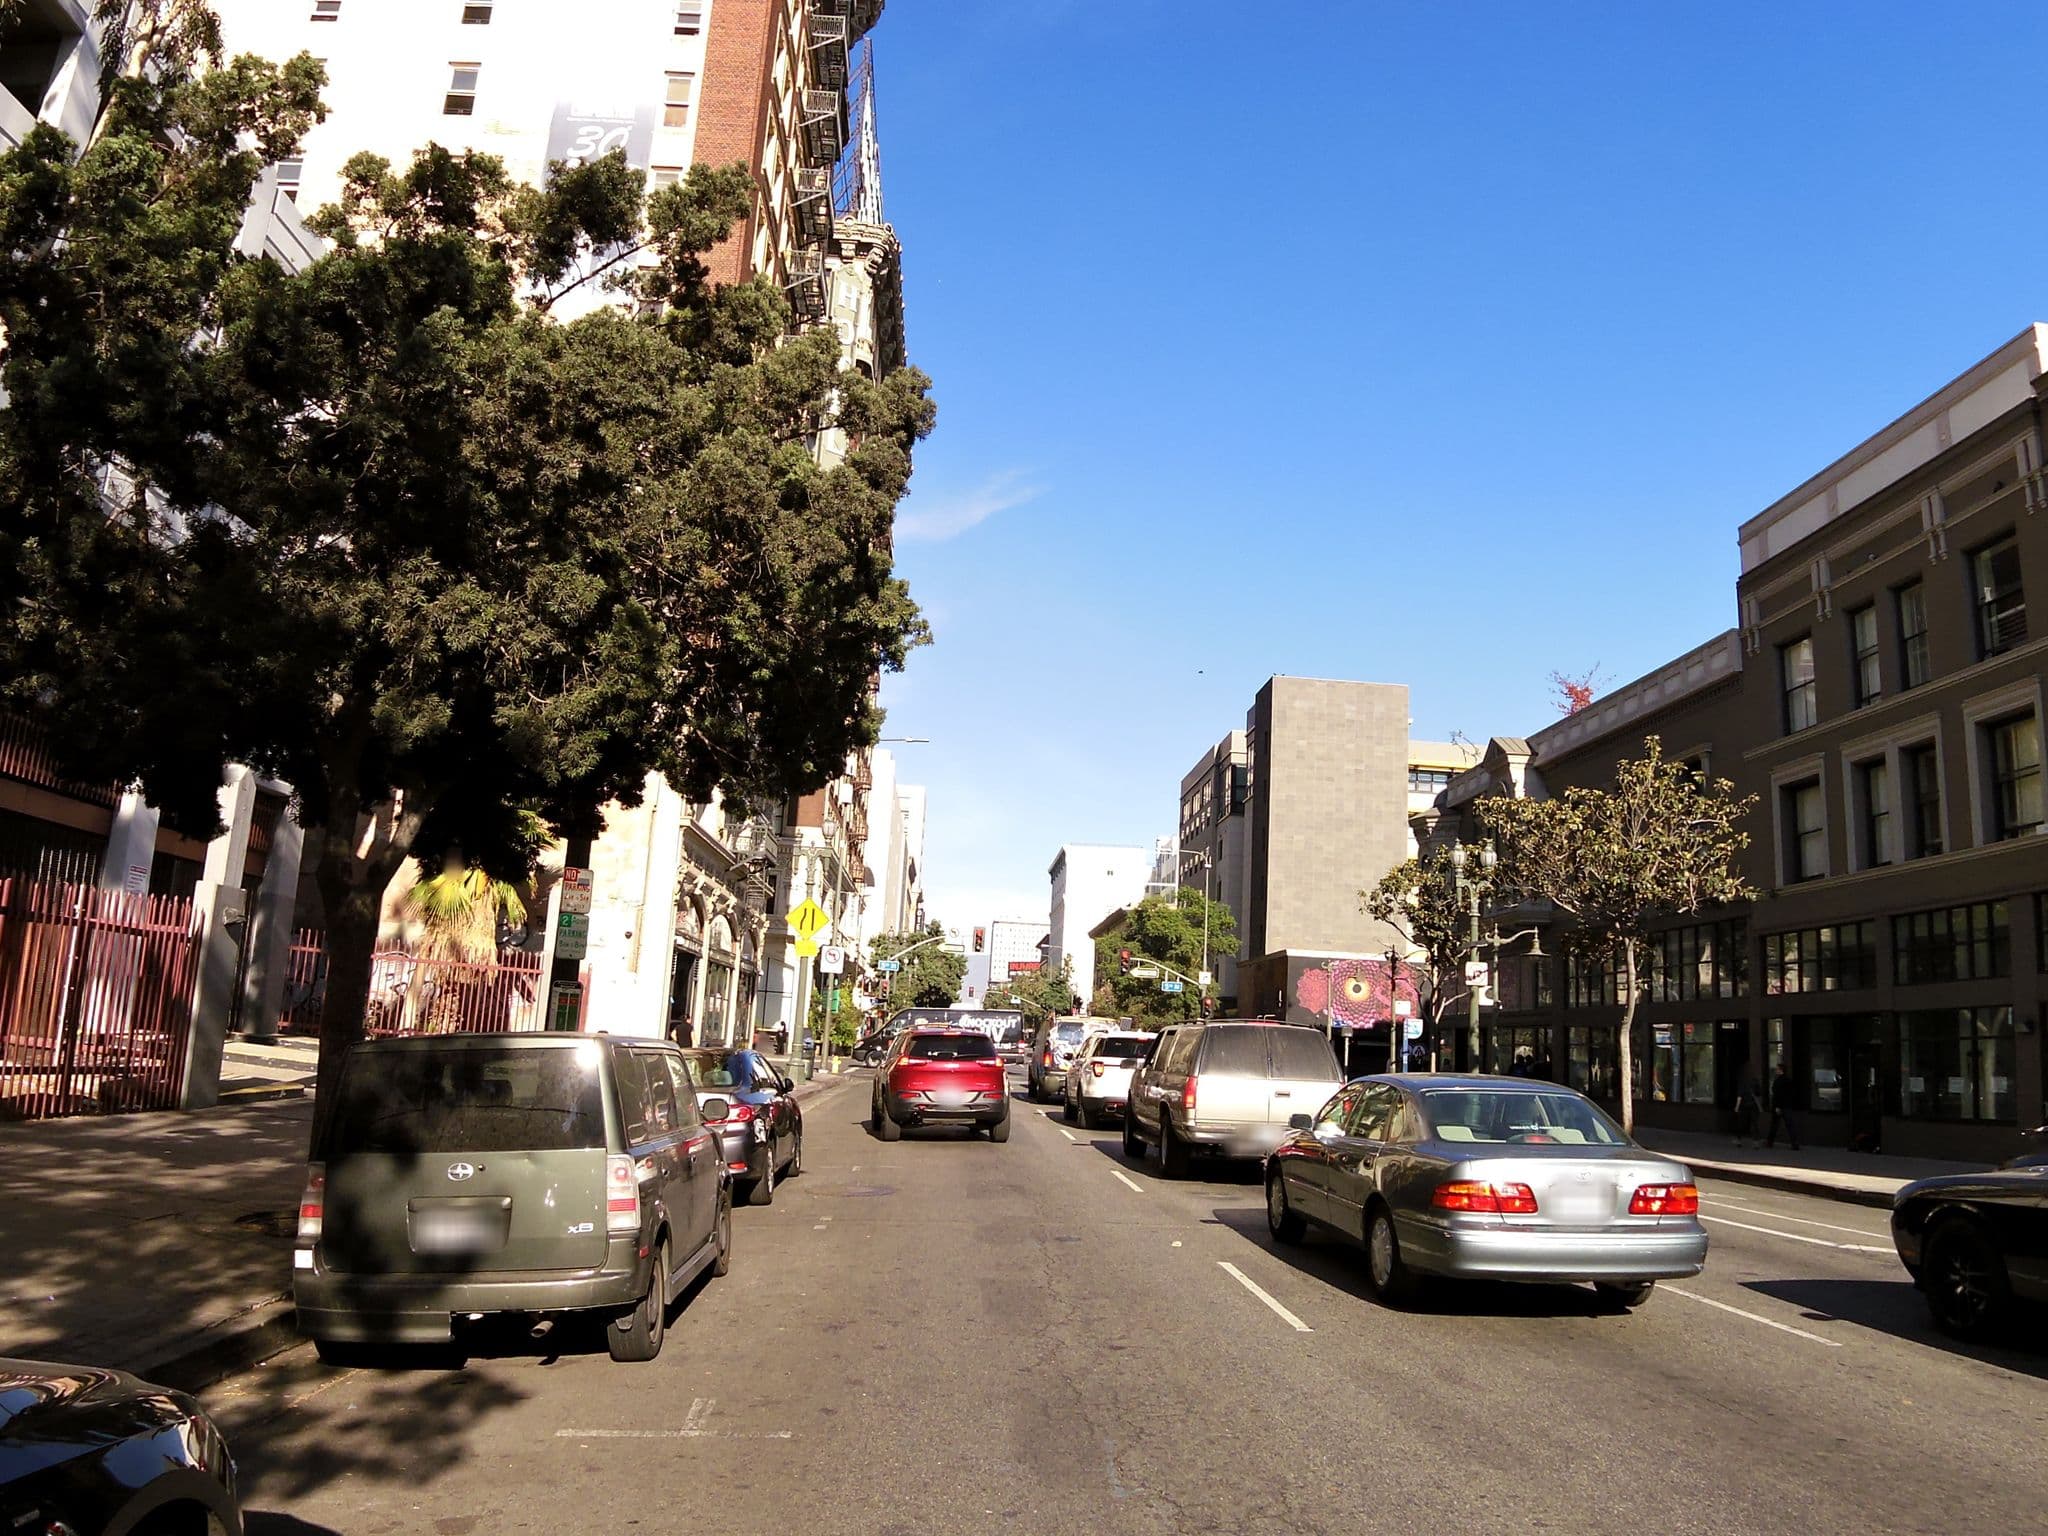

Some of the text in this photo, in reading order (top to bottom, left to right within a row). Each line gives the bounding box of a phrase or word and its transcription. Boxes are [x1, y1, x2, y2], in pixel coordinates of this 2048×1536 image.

[565, 869, 577, 881] NO
[564, 882, 591, 893] PARKING
[562, 915, 569, 926] 2
[559, 929, 587, 938] PARKING
[959, 1014, 1018, 1029] KNOCKOUT
[567, 1222, 594, 1234] xB
